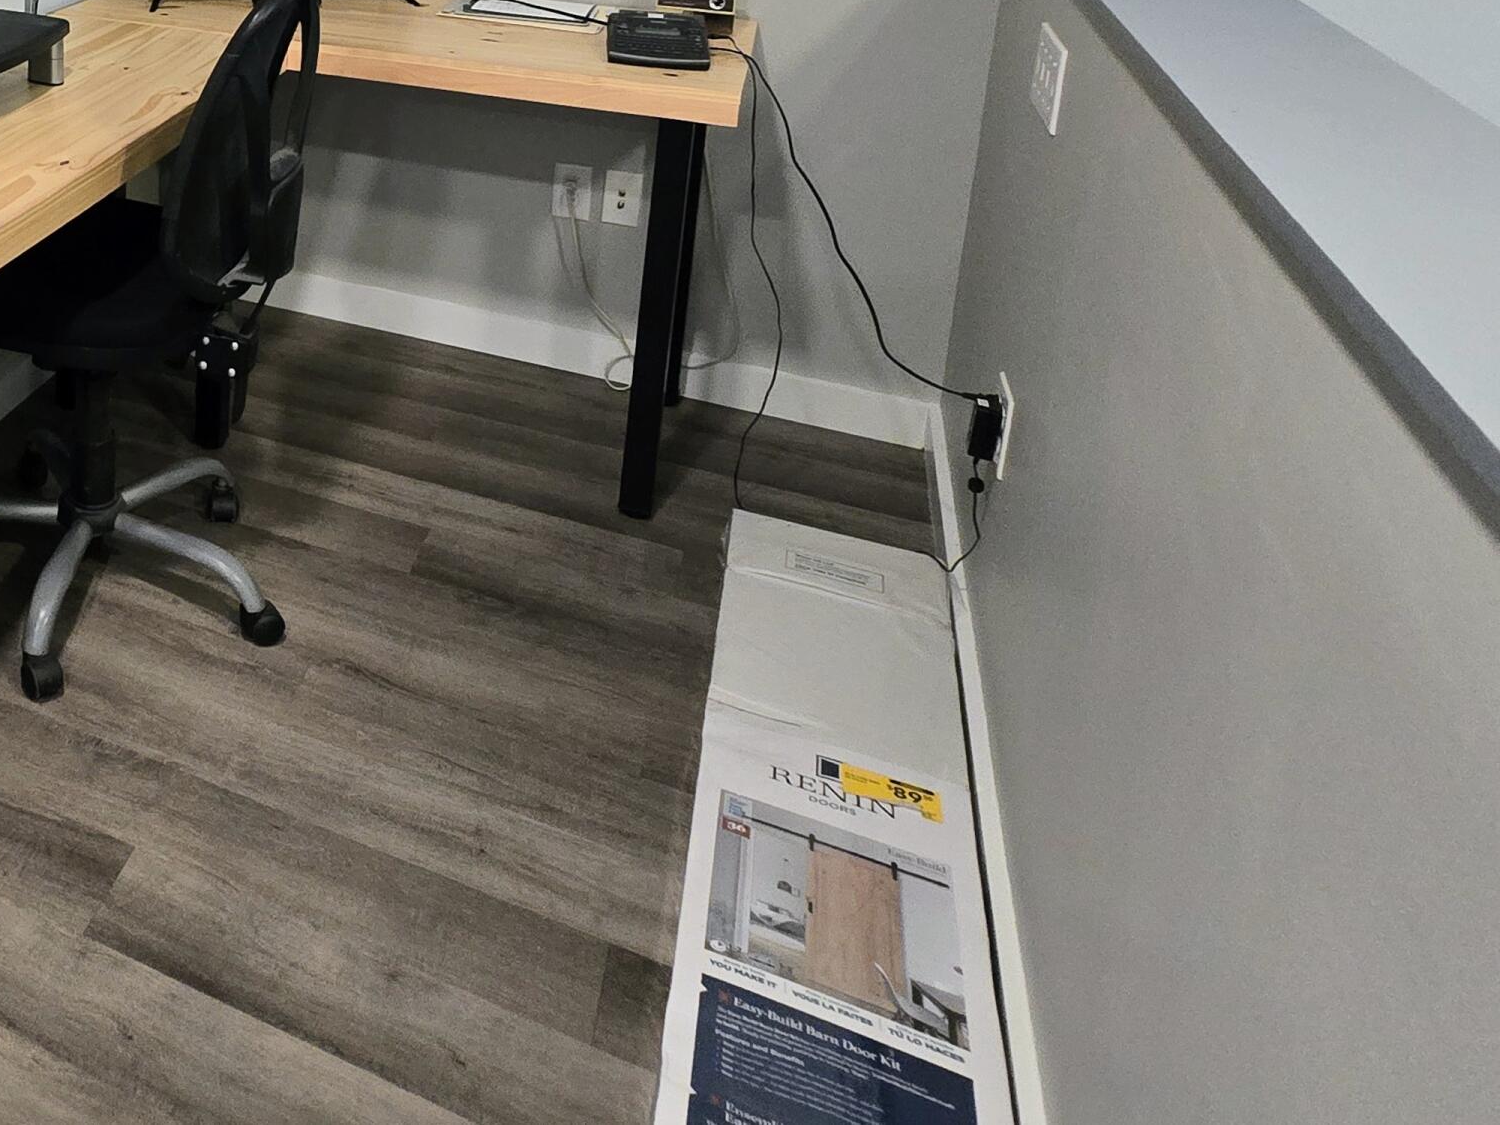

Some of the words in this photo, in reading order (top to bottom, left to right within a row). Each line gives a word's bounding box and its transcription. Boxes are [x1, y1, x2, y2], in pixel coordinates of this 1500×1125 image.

[770, 765, 895, 820] RENIN
[809, 795, 856, 816] DOORS
[709, 958, 732, 972] YOU
[734, 968, 765, 984] MAKE
[767, 980, 777, 988] IT
[792, 990, 819, 1006] VOUS
[822, 1001, 835, 1011] LA
[837, 1005, 874, 1027] FAITES
[715, 1028, 752, 1047] Features
[753, 1039, 769, 1053] and
[733, 996, 803, 1032] Easy-Build
[806, 1022, 839, 1045] Barn
[842, 1038, 876, 1061] Door
[880, 1053, 902, 1072] Kit
[908, 1034, 924, 1046] LO
[926, 1041, 966, 1063] HACES
